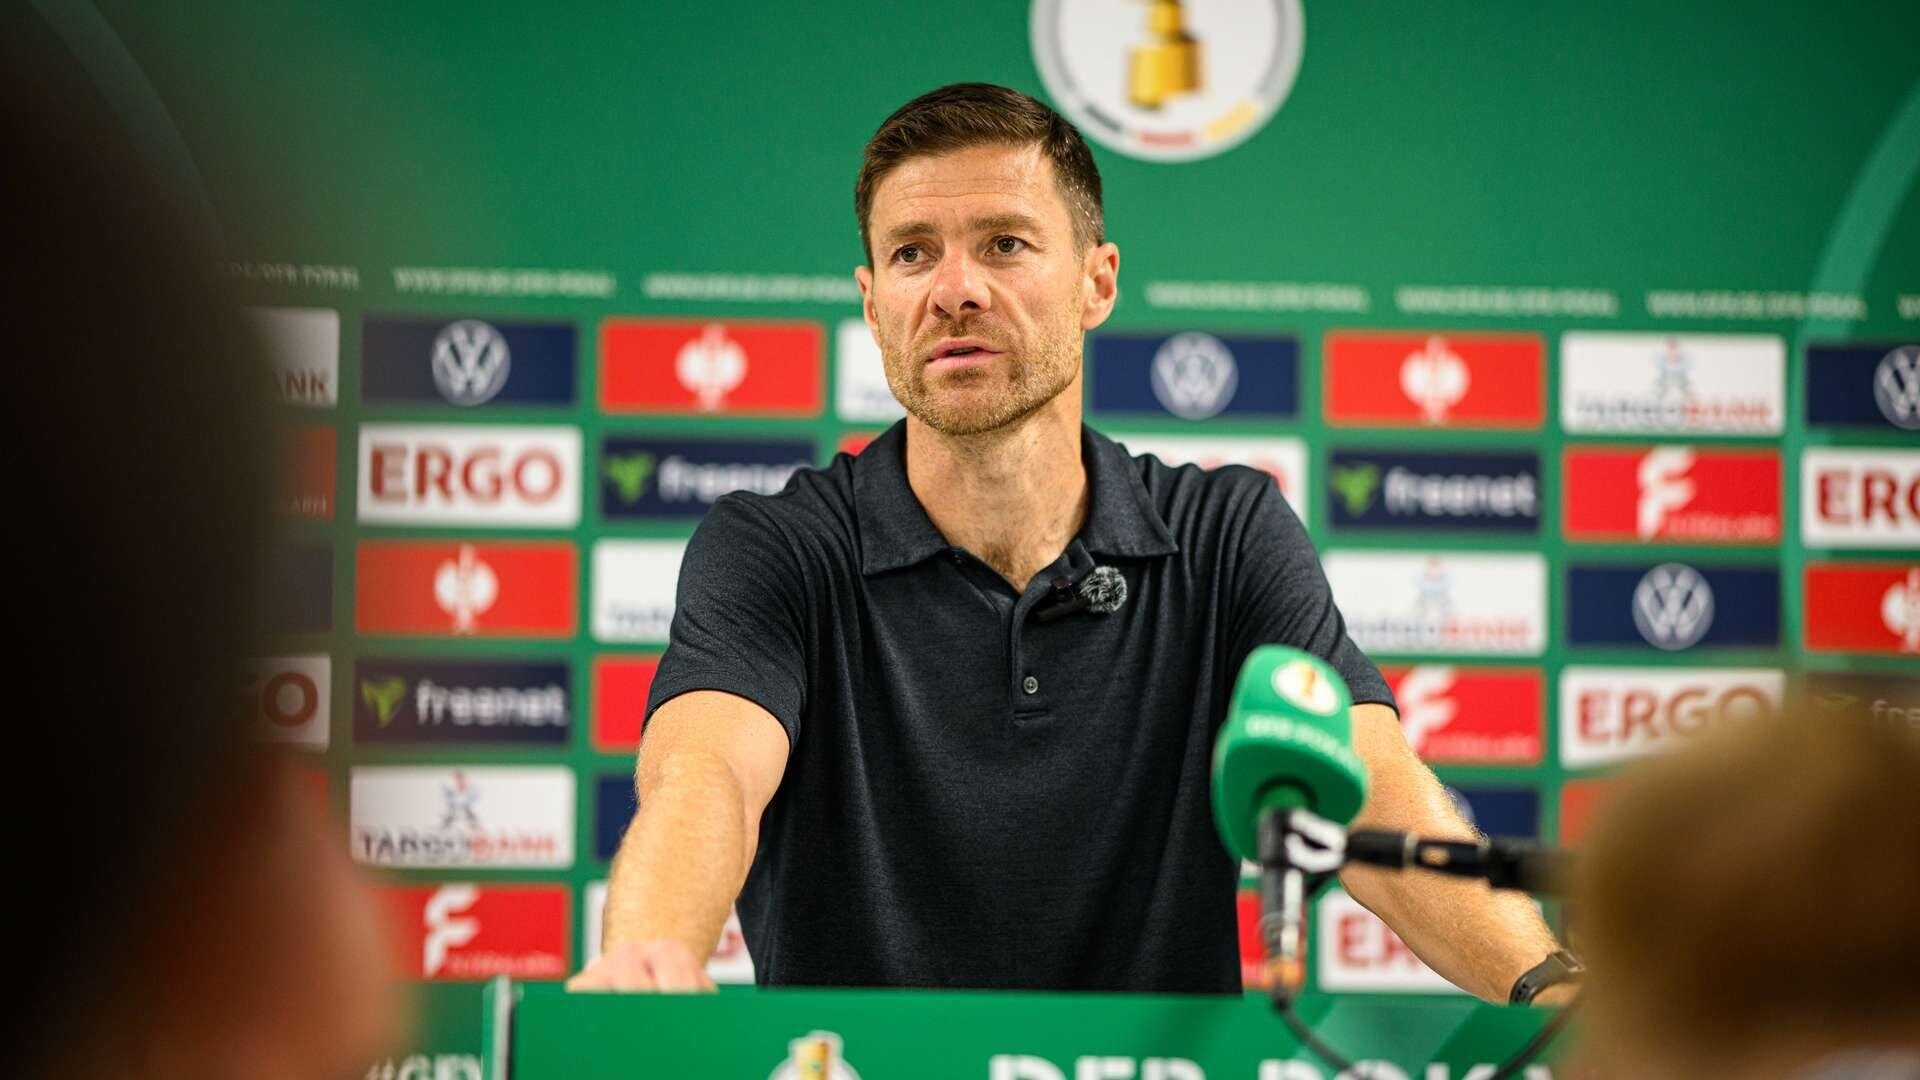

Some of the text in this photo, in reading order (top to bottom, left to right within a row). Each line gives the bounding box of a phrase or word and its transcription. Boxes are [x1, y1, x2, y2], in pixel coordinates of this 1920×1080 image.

[370, 443, 562, 507] ERGO
[1385, 464, 1537, 518] freenet
[416, 678, 567, 726] freenet
